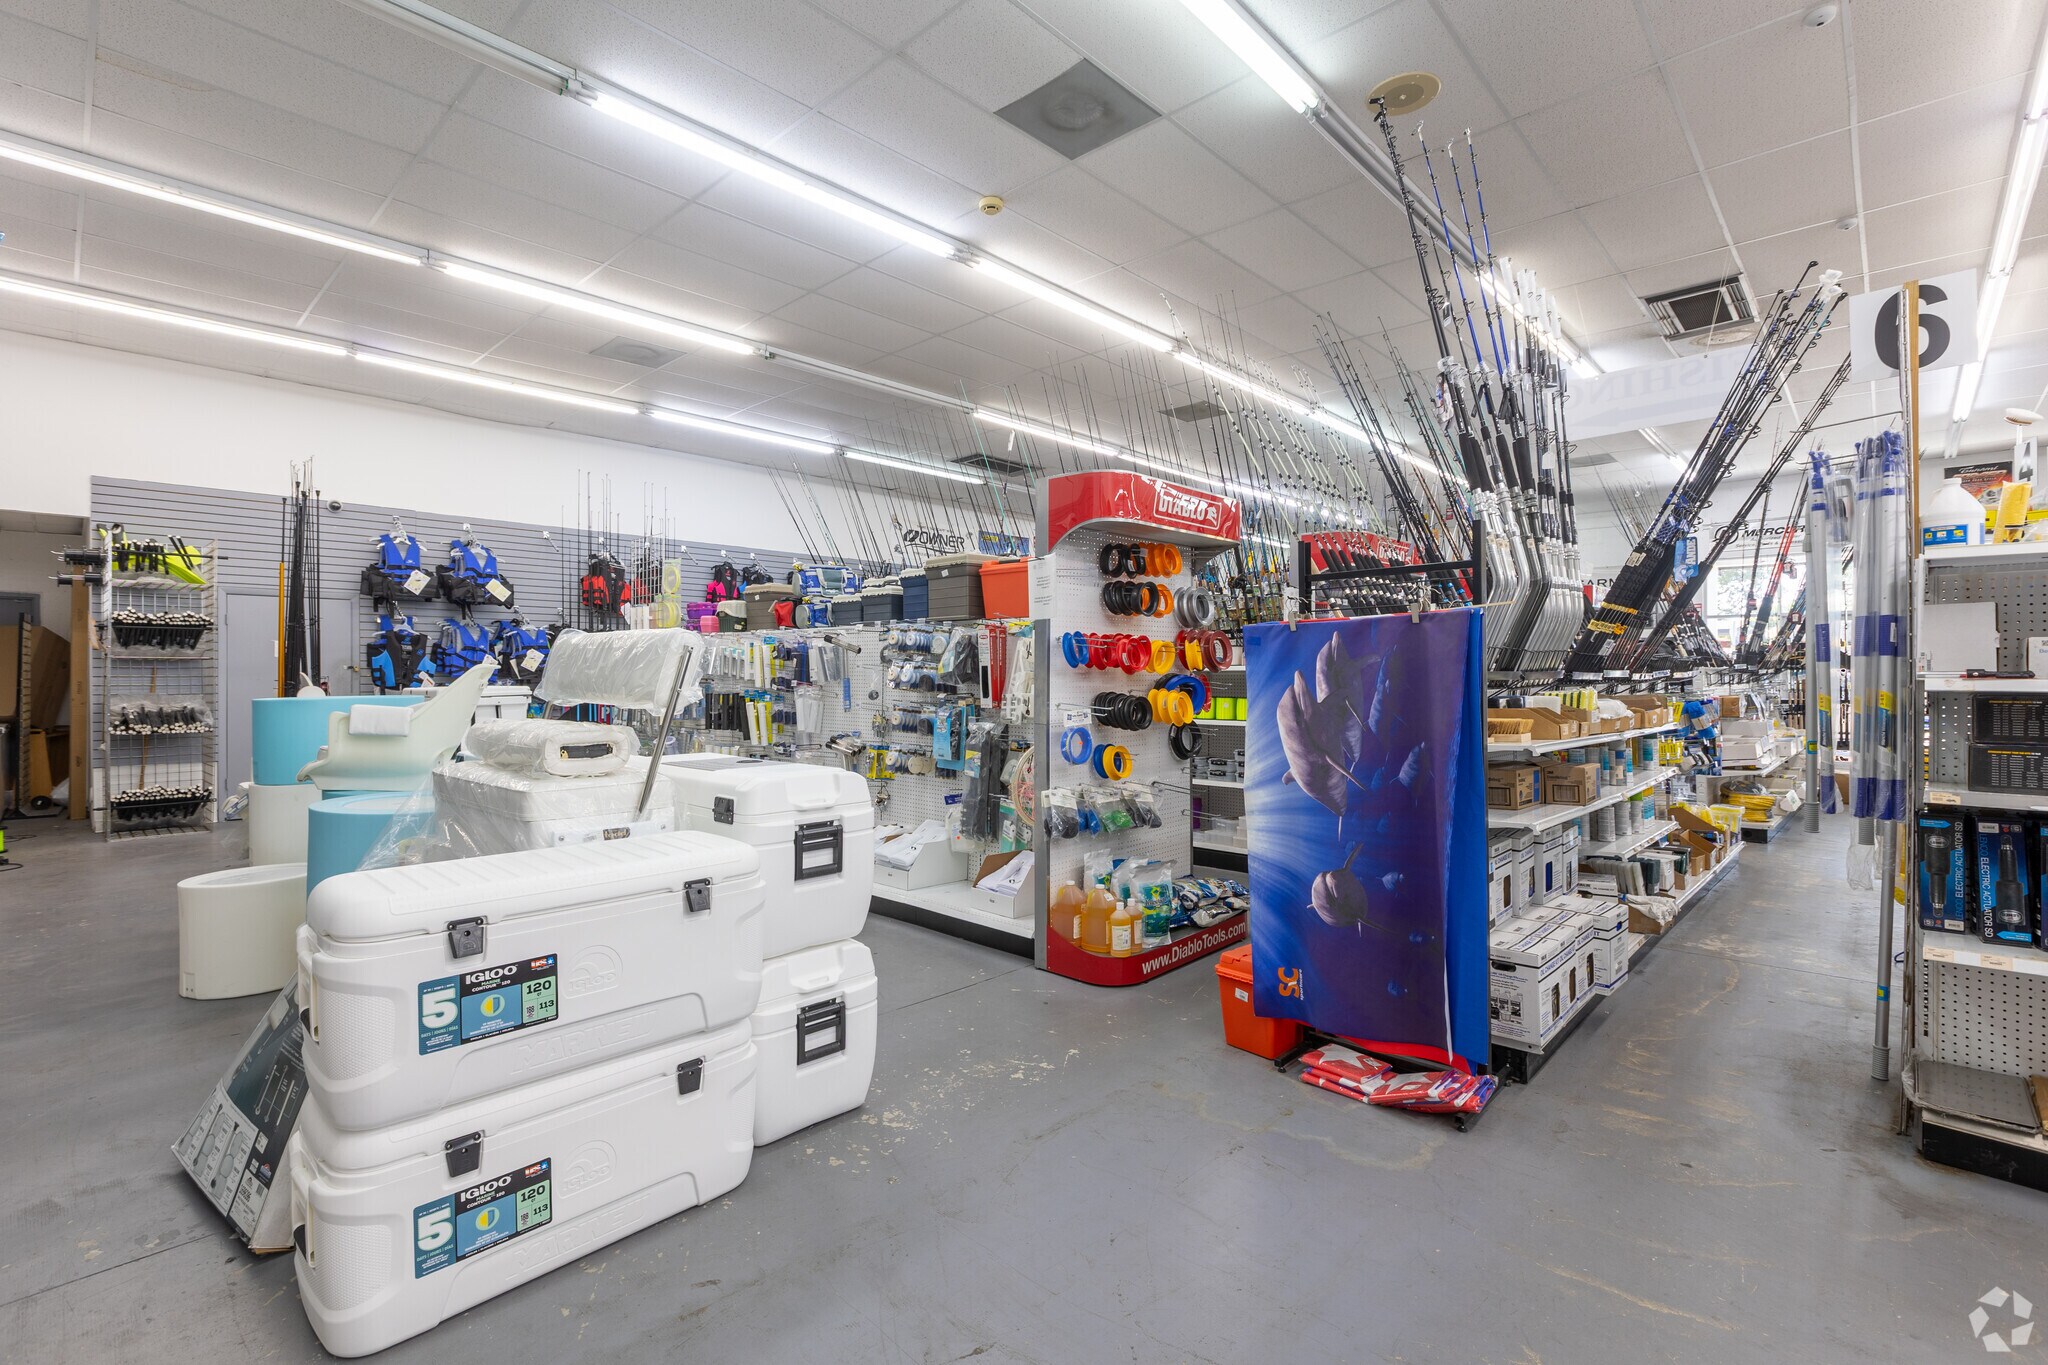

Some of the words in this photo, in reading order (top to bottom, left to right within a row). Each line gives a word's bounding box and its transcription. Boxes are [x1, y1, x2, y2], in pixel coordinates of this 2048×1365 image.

[1874, 284, 1951, 370] 6
[2018, 441, 2034, 481] 4
[918, 530, 965, 550] OWNER
[1954, 821, 1964, 831] SD
[1954, 832, 1964, 865] ACTUATOR
[1955, 866, 1964, 898] ELECTRIC
[1981, 857, 1991, 889] ELECTRIC
[1982, 889, 1993, 925] ACTUATOR
[1984, 926, 1994, 938] SD
[1141, 920, 1247, 975] www.DiabloTools.com
[465, 965, 518, 985] IGLOO
[471, 984, 497, 993] CONTOUR
[526, 980, 552, 995] 120
[1278, 967, 1300, 998] SC
[421, 988, 458, 1029] 5
[539, 999, 554, 1010] 113
[460, 1175, 512, 1203] IGLOO
[520, 1185, 546, 1202] 120
[533, 1203, 548, 1215] 113
[417, 1207, 454, 1251] 5
